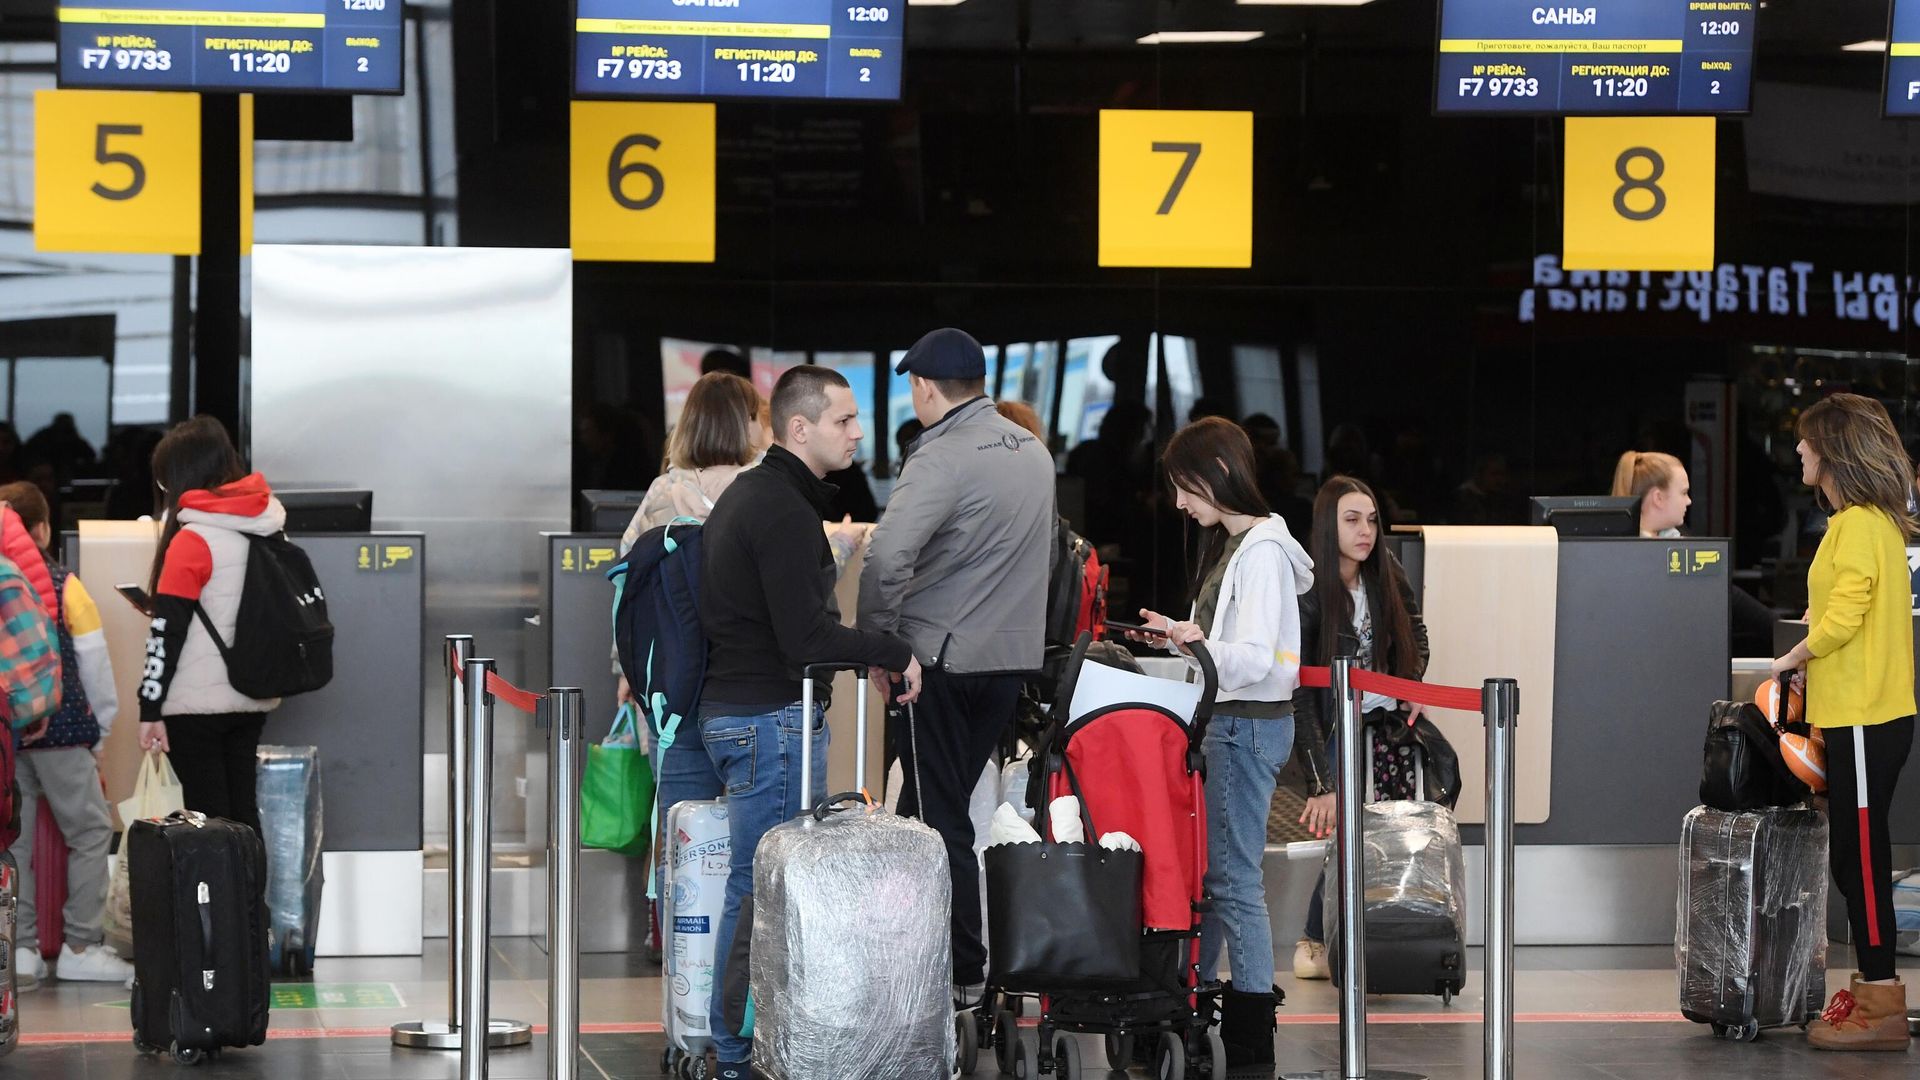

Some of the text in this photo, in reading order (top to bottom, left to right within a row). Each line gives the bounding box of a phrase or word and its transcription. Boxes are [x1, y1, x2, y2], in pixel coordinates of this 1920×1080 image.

[1689, 2, 1752, 11] ВРЕМЯ ВЫЛЕТА:
[847, 7, 889, 22] 12:00
[1531, 7, 1597, 25] САНЬЯ
[1700, 21, 1740, 35] 12:00
[97, 36, 156, 49] № РЕЙСА:
[205, 37, 314, 53] РЕГИСТРАЦИЯ ДО:
[1477, 41, 1647, 52] Приготовьте, пожалуйста, Ваш паспорт
[82, 48, 172, 70] F7 9733
[612, 45, 668, 58] № РЕЙСА:
[714, 48, 818, 63] РЕГИСТРАЦИЯ ДО:
[229, 52, 291, 73] 11:20
[357, 57, 369, 72] 2
[597, 58, 682, 80] F7 9733
[1473, 64, 1526, 76] № РЕЙСА:
[1701, 61, 1732, 71] ВЫХОД:
[737, 62, 796, 83] 11:20
[859, 67, 871, 82] 2
[1571, 65, 1670, 78] РЕГИСТРАЦИЯ ДО:
[1459, 77, 1539, 97] F7 9733
[1592, 78, 1648, 97] 11:20
[1710, 80, 1720, 94] 2
[91, 123, 146, 201] 5
[607, 133, 665, 211] 6
[1151, 142, 1202, 215] 7
[1612, 146, 1667, 221] 8
